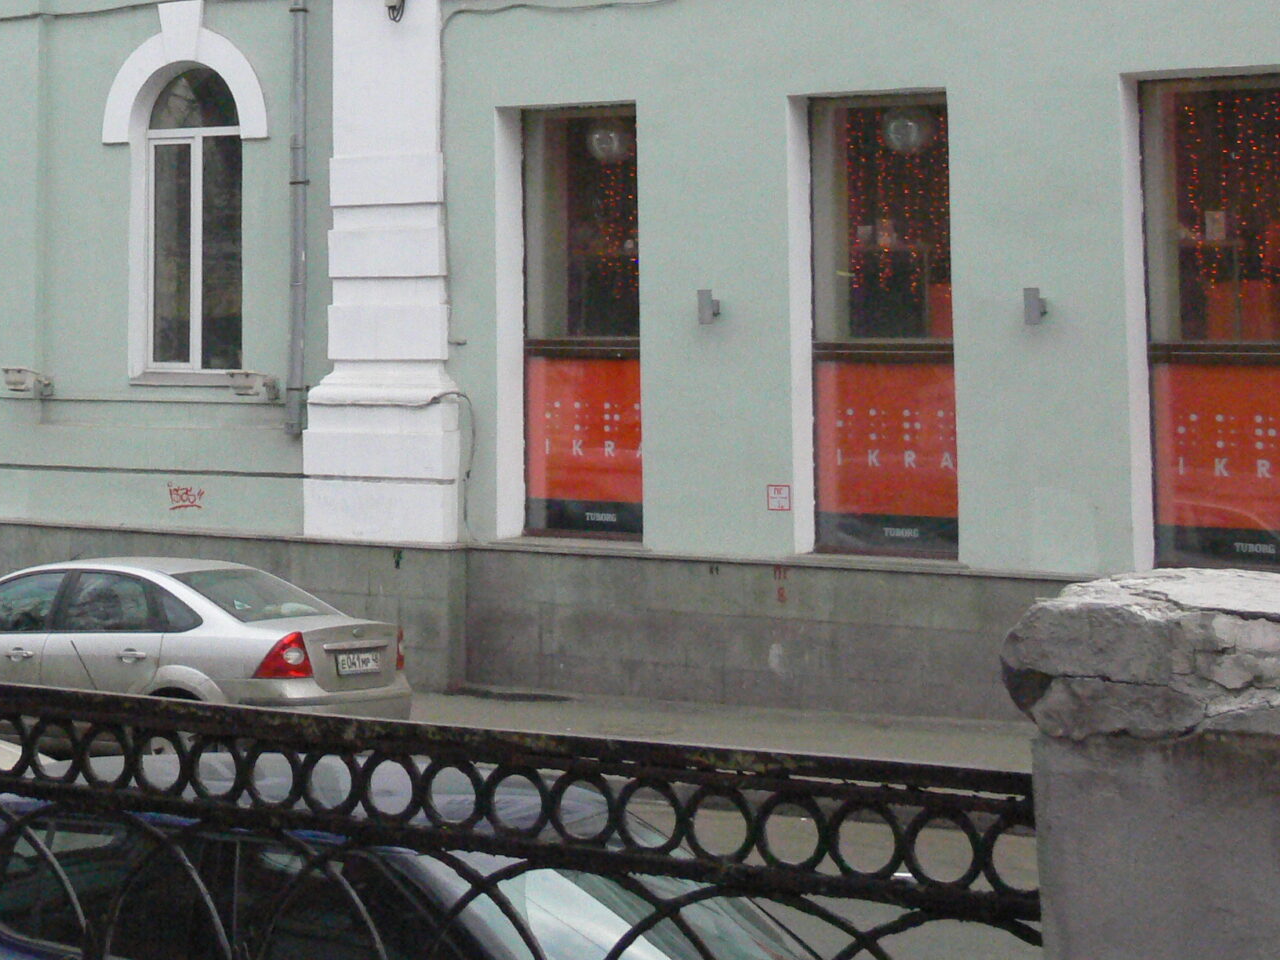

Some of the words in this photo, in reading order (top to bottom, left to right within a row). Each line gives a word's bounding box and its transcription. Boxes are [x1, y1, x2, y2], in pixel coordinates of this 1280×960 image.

[837, 448, 954, 470] IKRA
[585, 511, 617, 522] TUBORG
[883, 527, 919, 538] TUBORG
[1234, 542, 1276, 554] TUBORG
